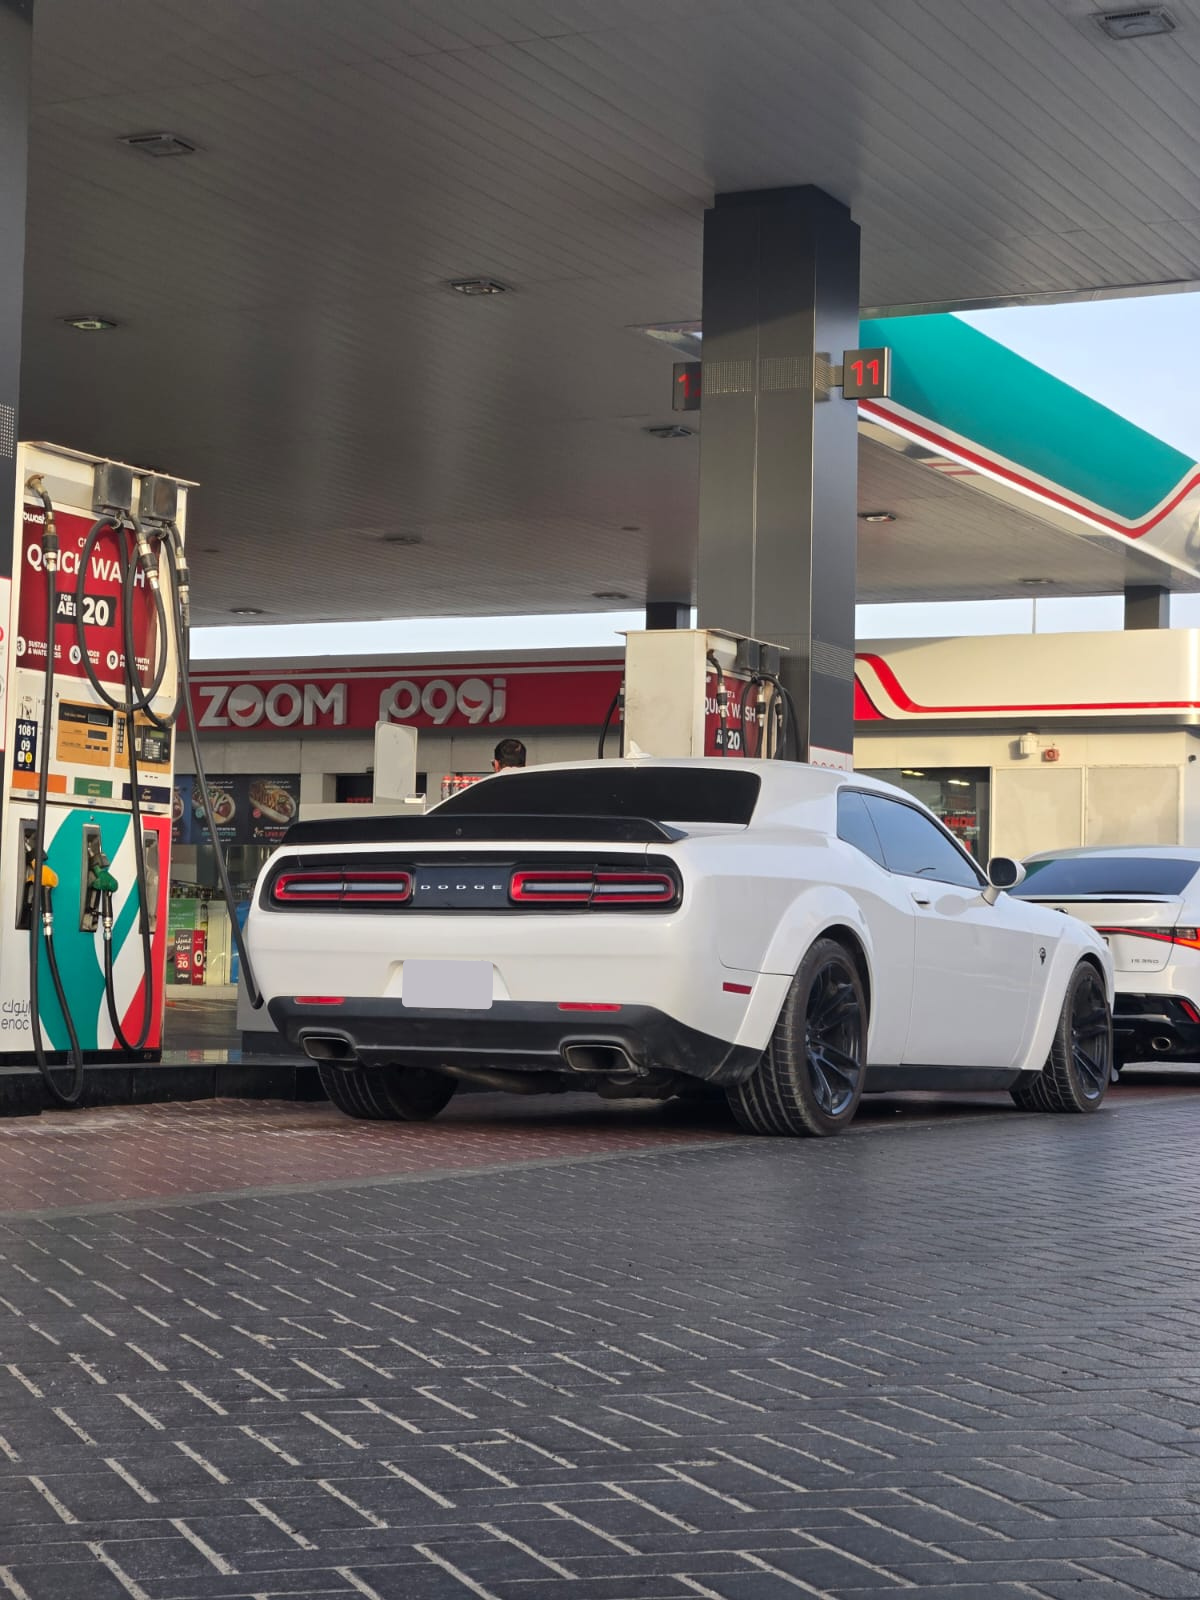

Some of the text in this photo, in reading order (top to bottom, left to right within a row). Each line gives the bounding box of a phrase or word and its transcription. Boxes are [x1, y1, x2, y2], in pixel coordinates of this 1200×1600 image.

[850, 359, 879, 386] 11
[678, 373, 700, 398] 1
[91, 556, 145, 588] WAH
[82, 596, 109, 627] 20
[199, 684, 347, 728] ZOOM
[731, 702, 756, 723] WSH
[18, 724, 36, 737] 1081
[727, 730, 740, 751] 20
[21, 740, 31, 751] 09
[176, 960, 189, 969] 20
[1, 1018, 30, 1031] enoc
